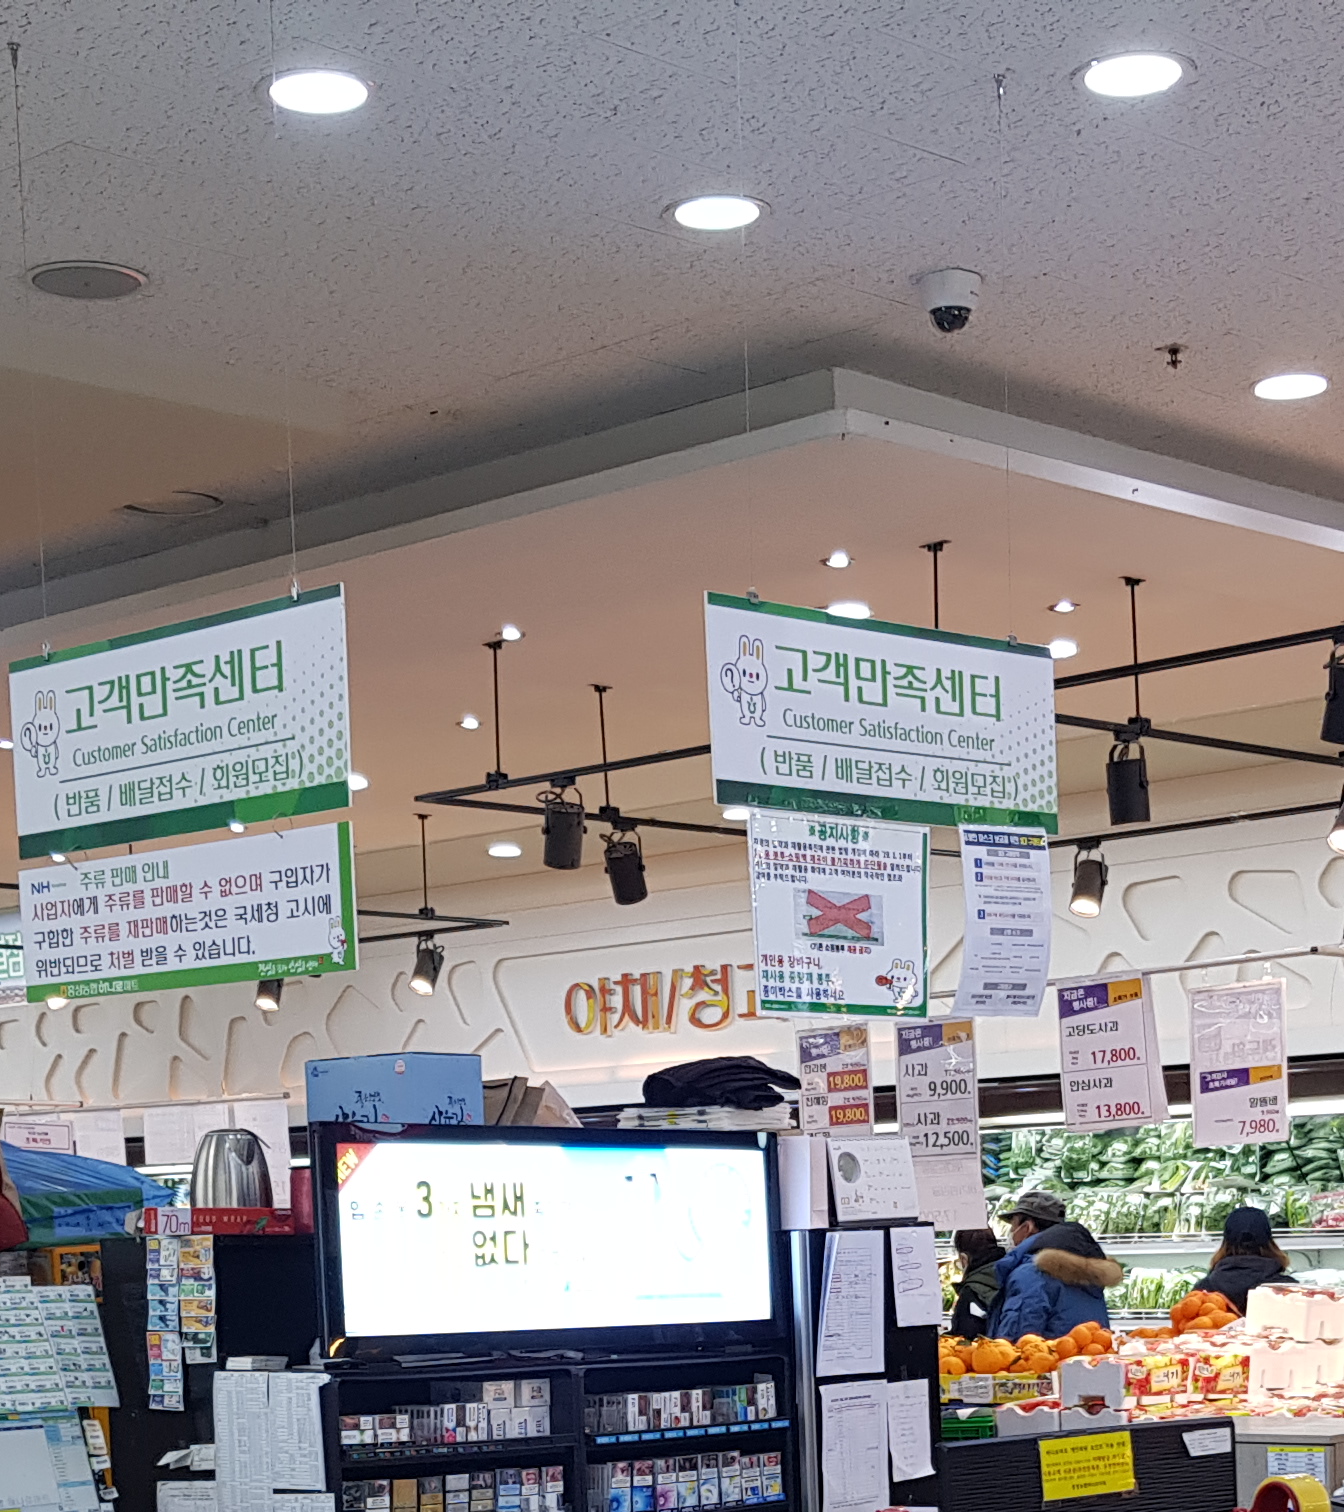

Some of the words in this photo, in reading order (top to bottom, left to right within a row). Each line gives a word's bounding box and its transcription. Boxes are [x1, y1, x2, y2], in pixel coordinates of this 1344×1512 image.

[65, 640, 284, 734] 고객만족센터
[774, 644, 1002, 722] 고객만족센터
[73, 742, 136, 767] Customer
[141, 724, 223, 755] Satisfaction
[228, 713, 277, 738] Center
[783, 709, 854, 735] Customer
[859, 718, 943, 746] Satisfaction
[948, 729, 995, 752] Center
[31, 880, 51, 896] NH
[80, 871, 105, 891] 주류
[110, 868, 137, 888] 판매
[142, 860, 169, 882] 안내
[32, 895, 99, 922] 사업자에게
[105, 889, 145, 914] 주류를
[151, 883, 193, 907] 판매할
[199, 880, 211, 898] 수
[218, 872, 263, 898] 없으며
[269, 862, 331, 890] 구입자가
[80, 925, 120, 945] 주류를
[126, 910, 228, 939] 재판매하는것은
[234, 902, 279, 925] 국세청
[286, 894, 332, 921] 고시에
[36, 954, 103, 978] 위반되므로
[108, 949, 135, 971] 처벌
[140, 946, 166, 968] 받을
[173, 943, 186, 963] 수
[193, 935, 256, 962] 있습니다.
[761, 954, 784, 967] 개인용
[762, 970, 784, 983] 재사용
[789, 972, 813, 984] 종량제
[1066, 1021, 1119, 1037] 고당도사과
[904, 1063, 928, 1077] 사과
[1069, 1077, 1113, 1092] 안심사과
[916, 1112, 940, 1126] 사과
[337, 1148, 358, 1183] NEW
[470, 1182, 525, 1218] 냄새
[161, 1214, 190, 1234] 70m
[472, 1230, 529, 1266] 없다
